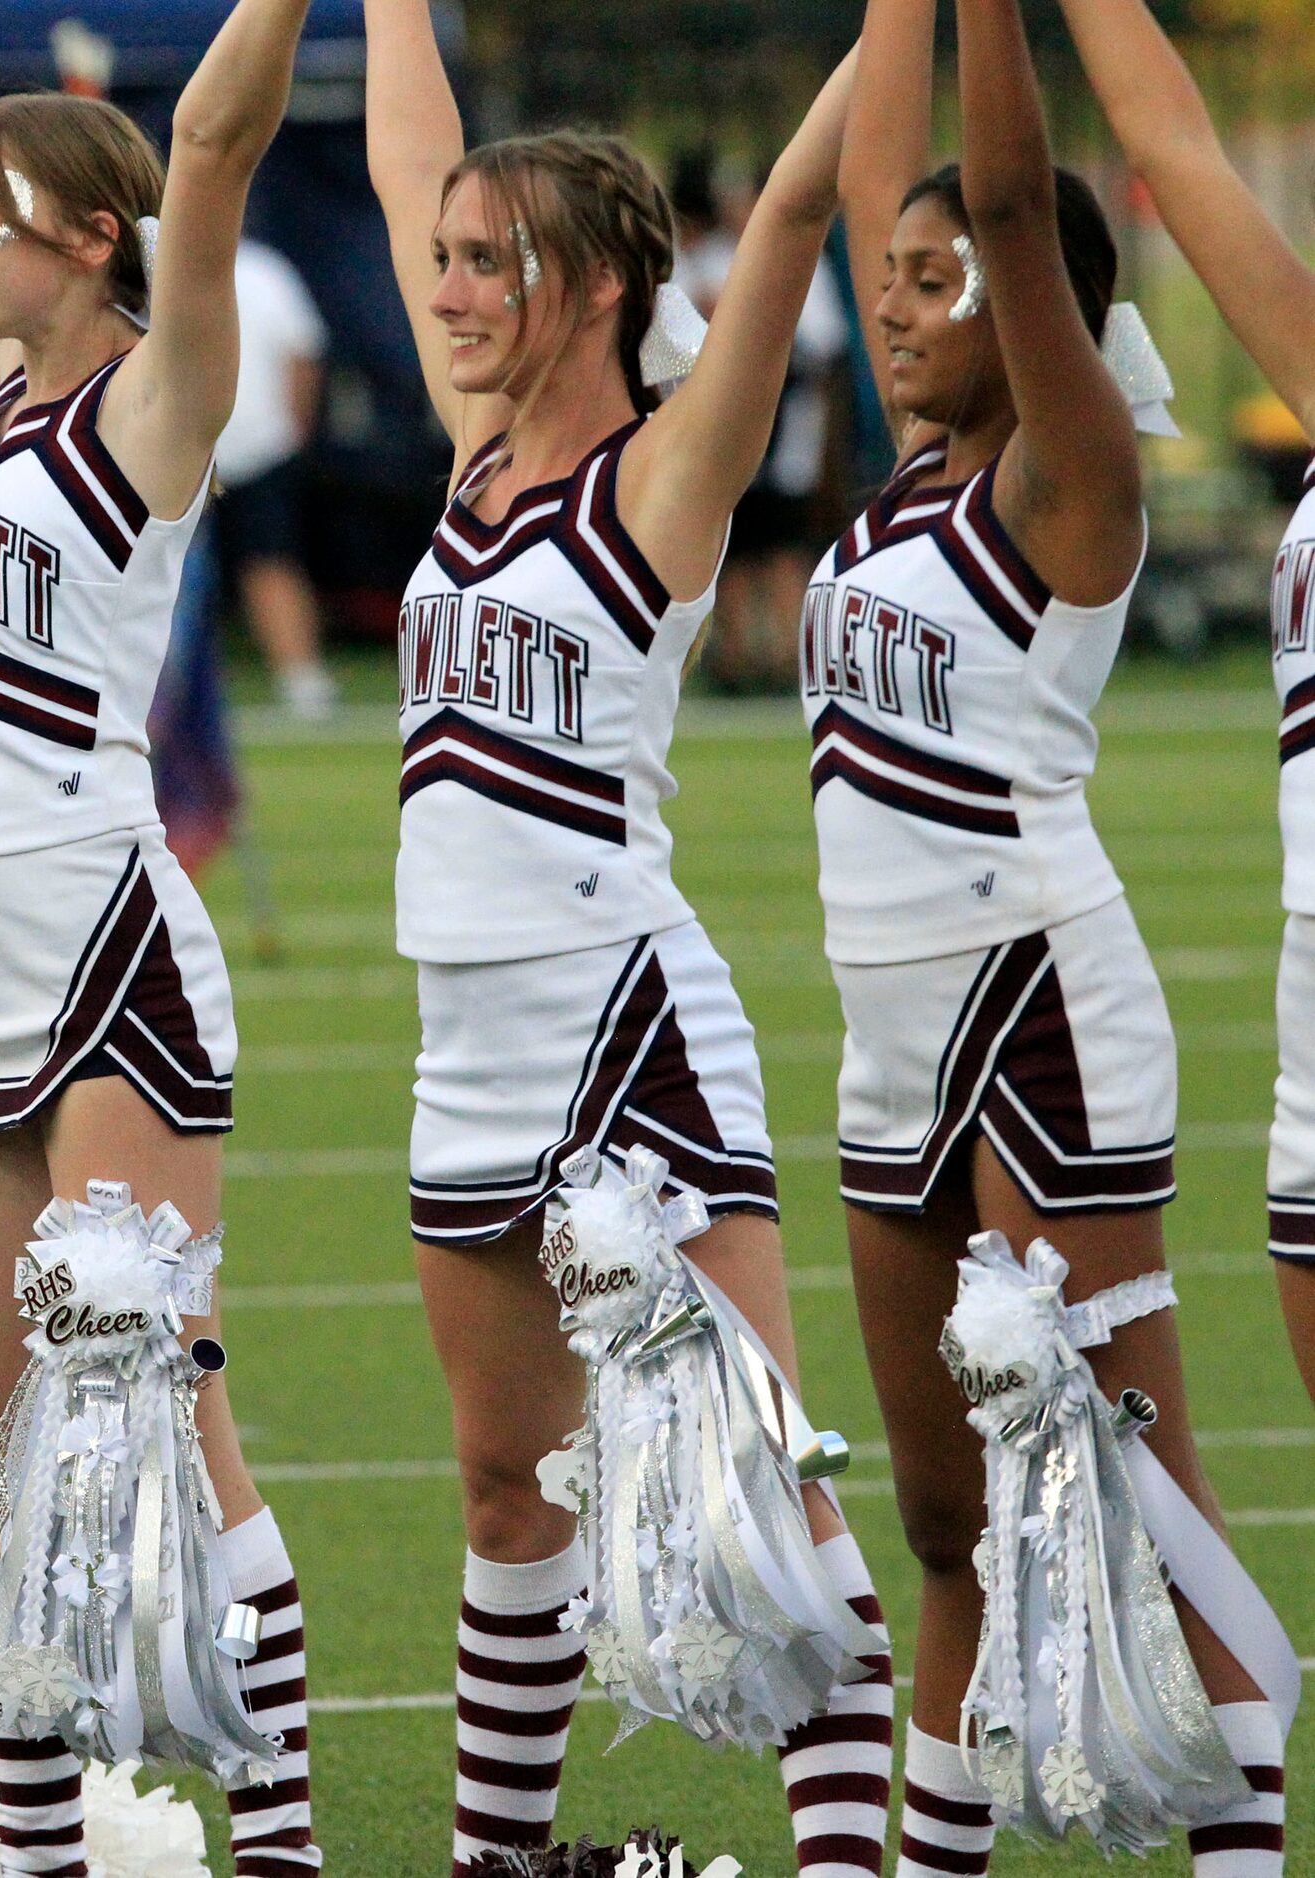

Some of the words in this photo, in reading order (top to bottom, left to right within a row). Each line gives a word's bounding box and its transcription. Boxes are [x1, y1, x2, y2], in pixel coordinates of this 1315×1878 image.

[22, 1262, 75, 1317] RHS
[558, 1259, 637, 1309] Cheer
[44, 1302, 150, 1347] Cheer
[157, 1591, 177, 1625] 21
